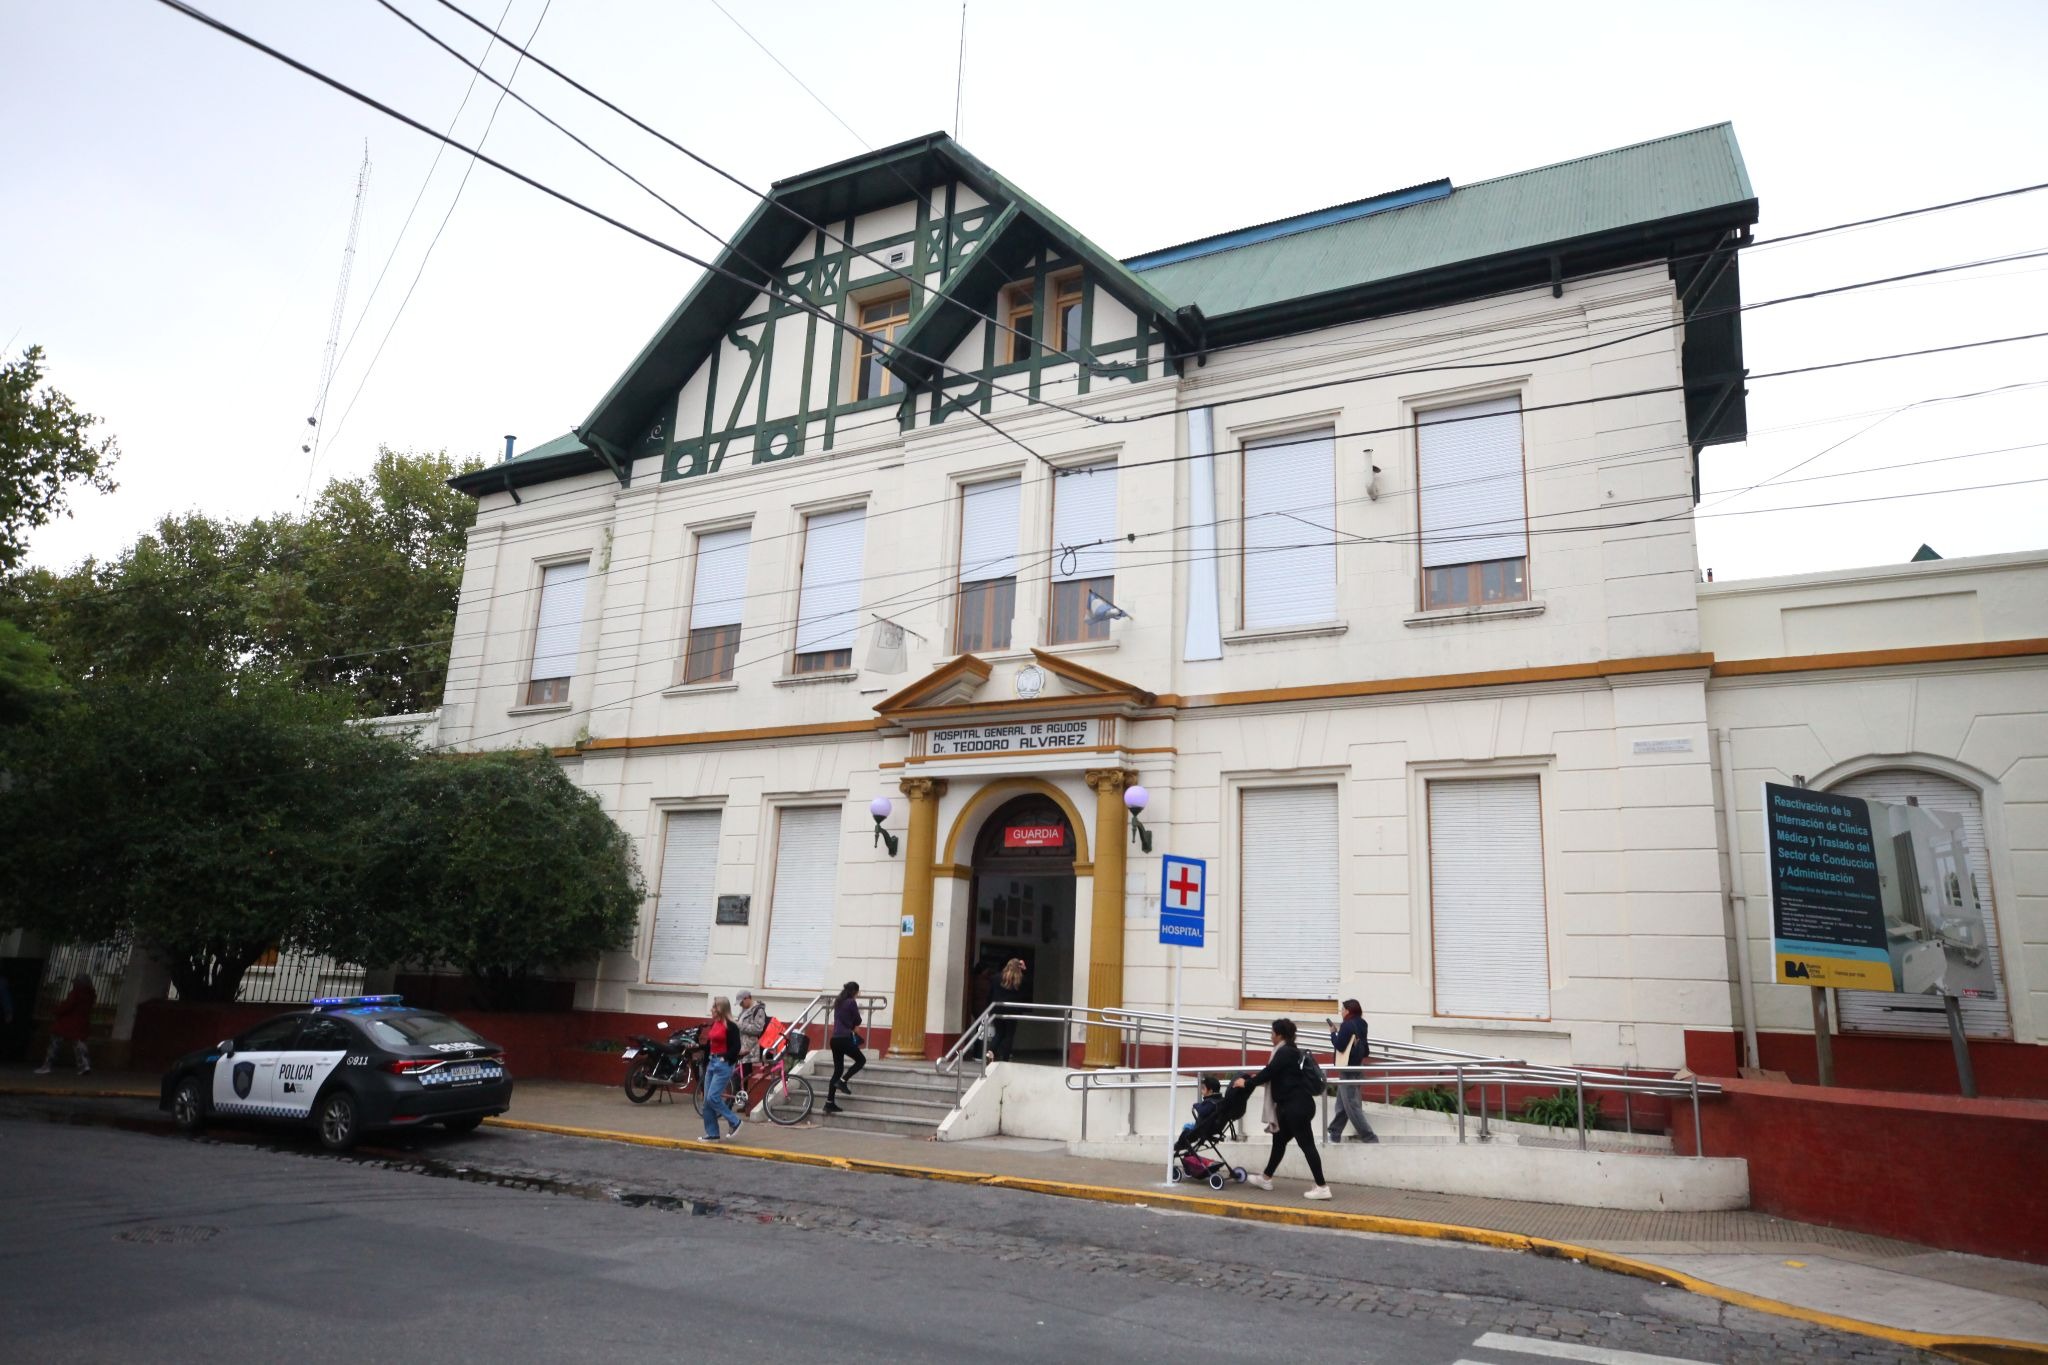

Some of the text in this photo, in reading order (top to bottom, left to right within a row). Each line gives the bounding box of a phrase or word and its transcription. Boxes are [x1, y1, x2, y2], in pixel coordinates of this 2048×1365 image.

[934, 721, 1087, 741] HOSPITAL GENERAL DE AGUDOS
[933, 734, 1085, 754] Dr. TEODORO ALVAREZ
[1774, 795, 1851, 817] Reactivación de la
[1775, 812, 1824, 829] Internación
[1826, 820, 1837, 831] de
[1013, 828, 1059, 839] GUARDIA
[1776, 830, 1870, 852] Médica y Traslado del
[1777, 847, 1875, 869] Sector de Conducción
[1779, 865, 1855, 884] y Administración
[1161, 924, 1202, 938] HOSPITAL
[1785, 960, 1810, 979] BA
[353, 1056, 369, 1066] 911
[279, 1063, 314, 1081] POLICIA
[283, 1082, 297, 1093] BA
